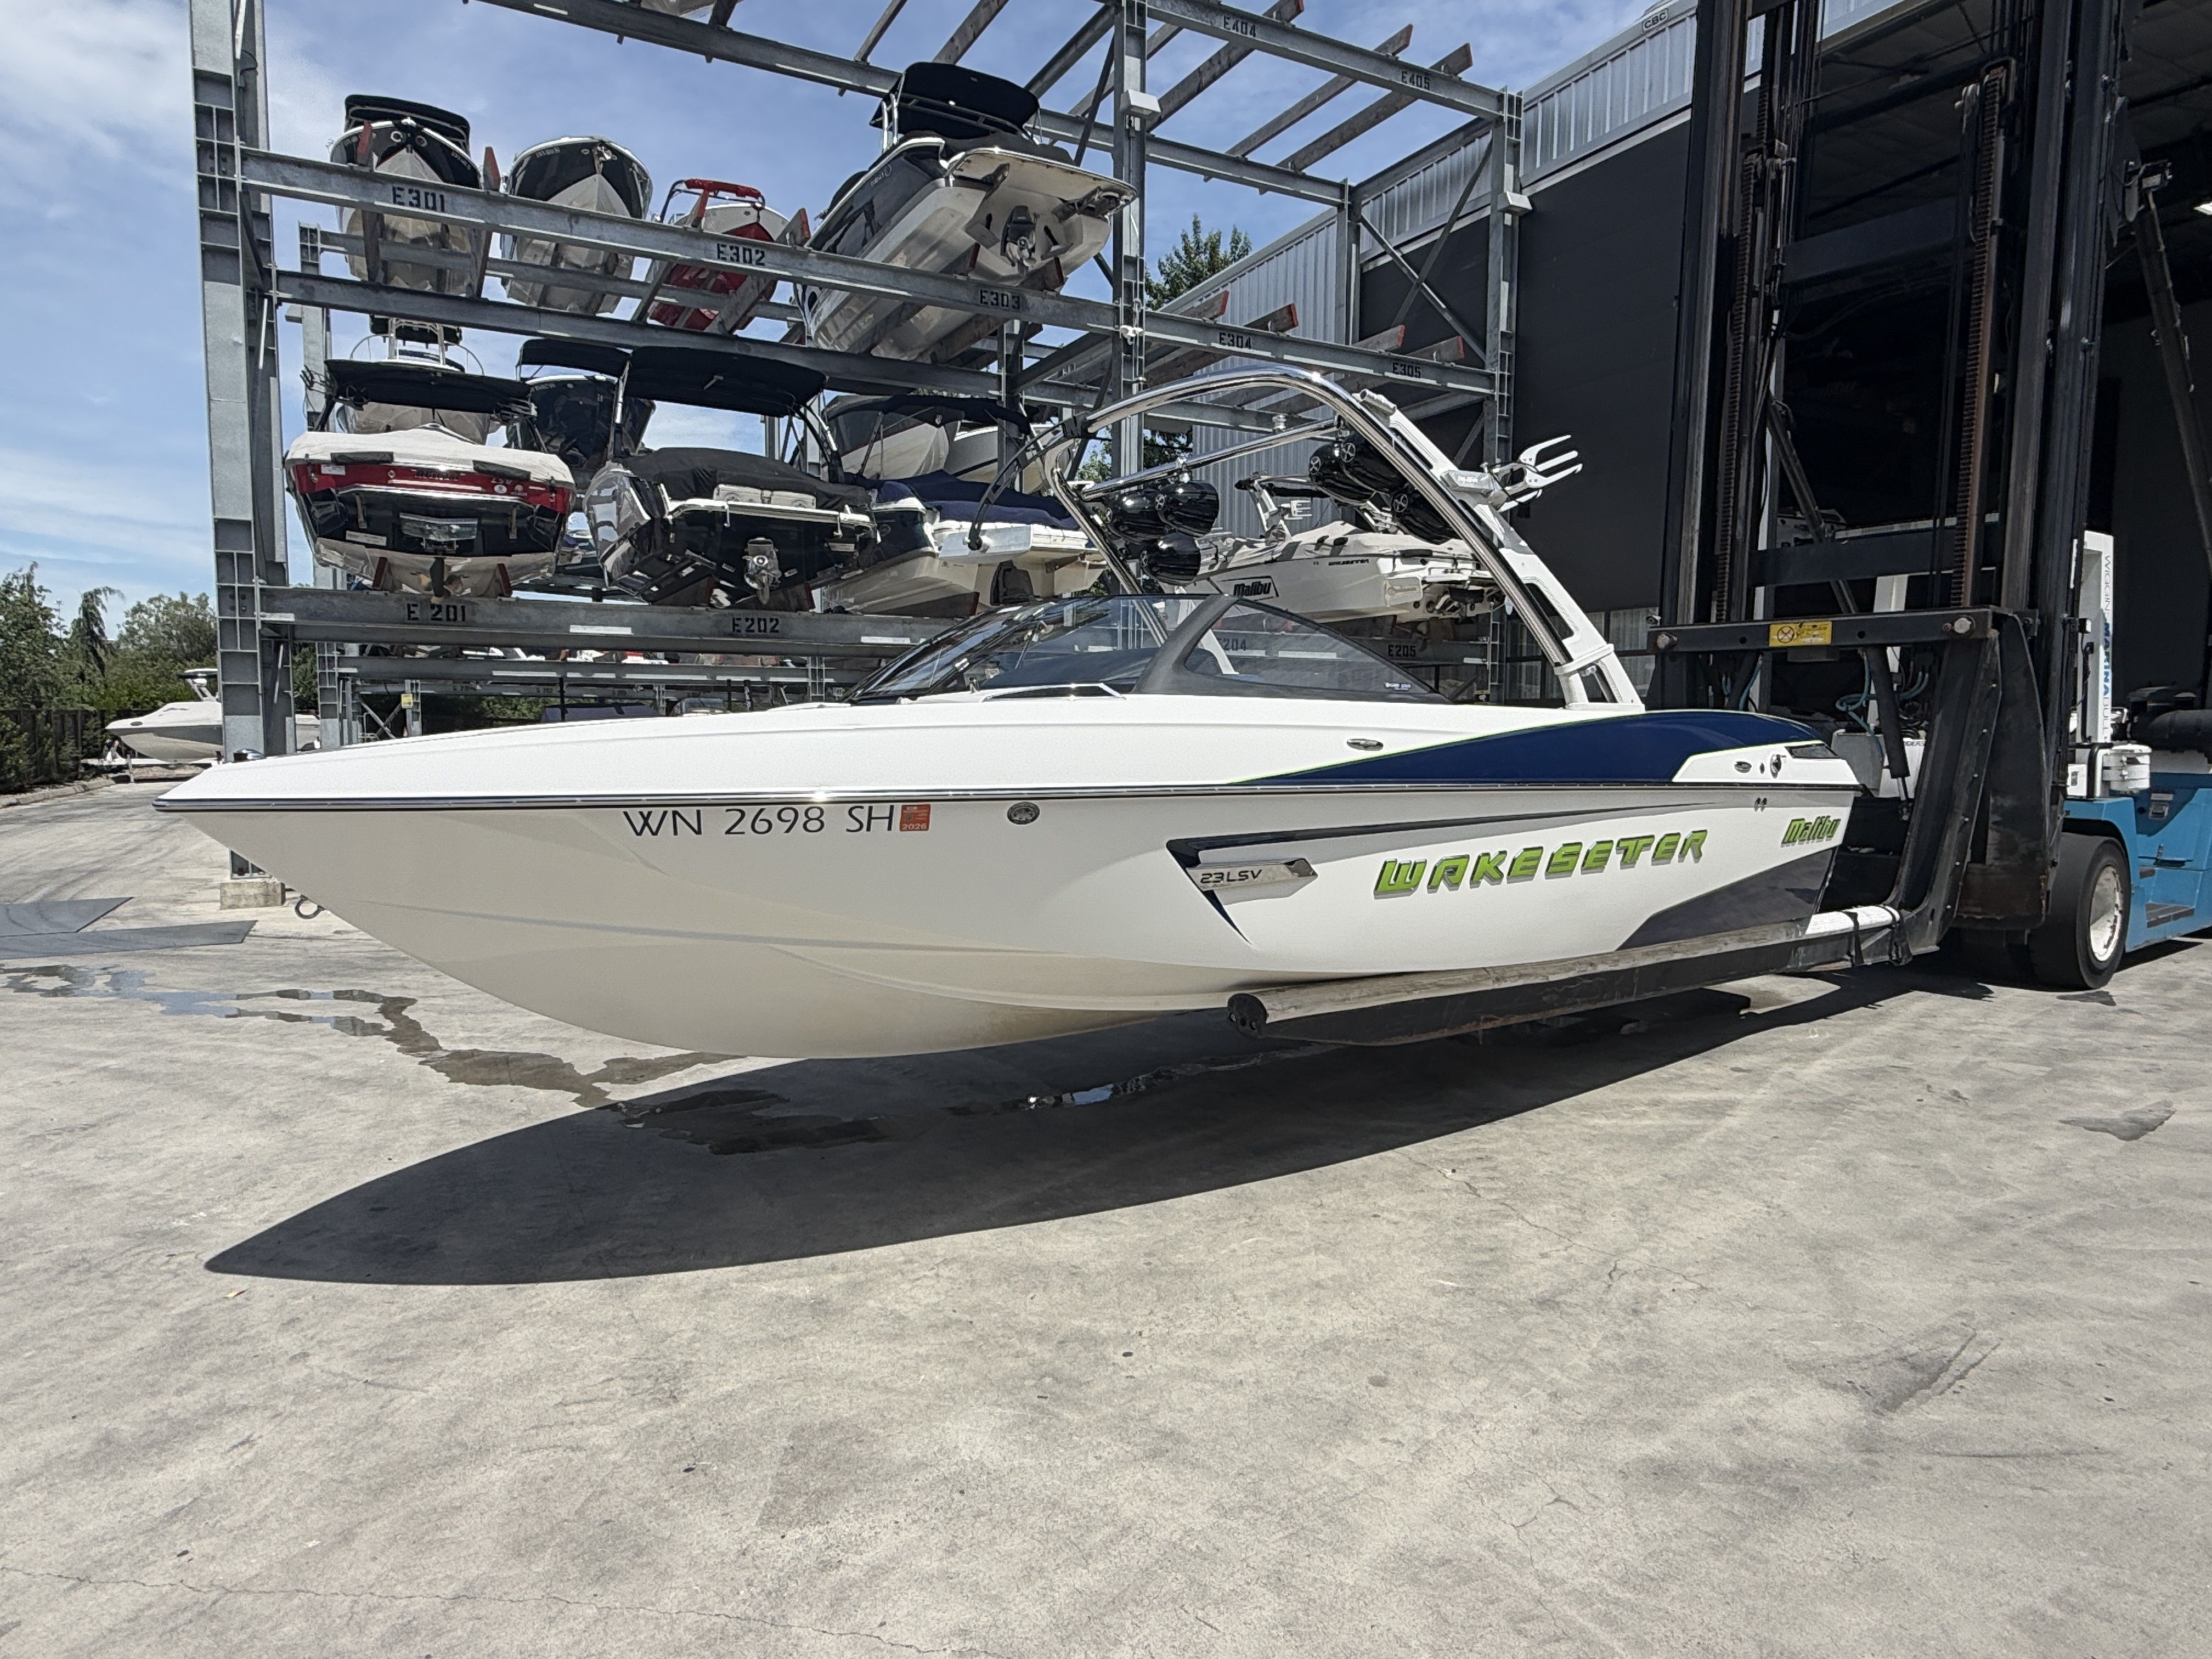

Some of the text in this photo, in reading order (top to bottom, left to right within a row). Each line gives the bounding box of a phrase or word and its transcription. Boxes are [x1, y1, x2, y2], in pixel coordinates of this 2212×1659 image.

[1223, 15, 1256, 38] E404
[1401, 70, 1430, 91] E405
[392, 185, 445, 213] E301
[716, 243, 765, 266] E302
[980, 289, 1021, 310] E303
[1219, 332, 1252, 350] E304
[1392, 362, 1422, 379] E305
[1233, 580, 1272, 597] Malibu
[407, 603, 466, 622] E 201
[732, 617, 780, 633] E202
[1388, 644, 1416, 657] E205
[622, 809, 703, 837] WN
[724, 806, 825, 836] 2698
[845, 805, 895, 833] SH
[1780, 815, 1841, 845] Malibu
